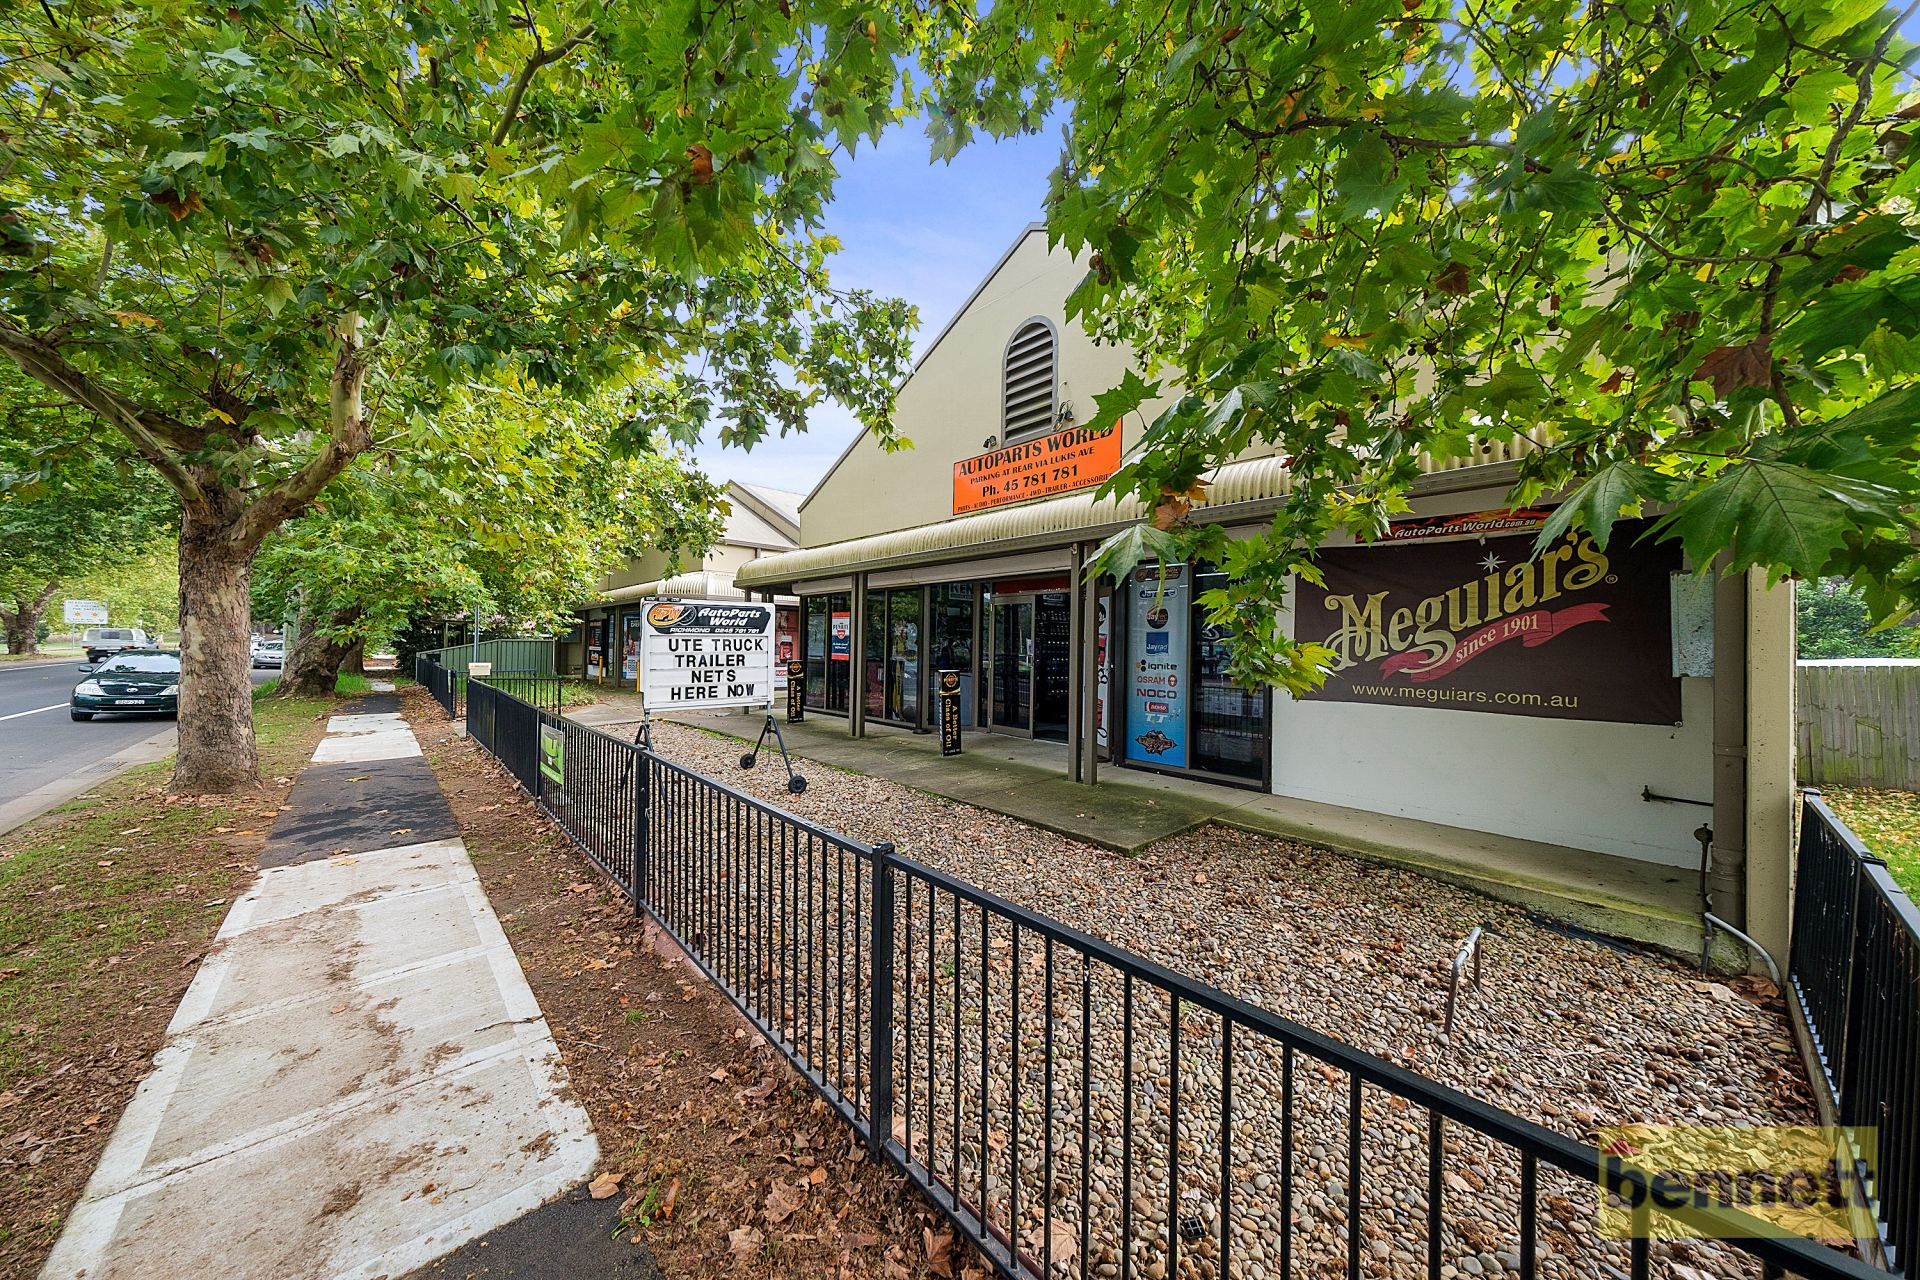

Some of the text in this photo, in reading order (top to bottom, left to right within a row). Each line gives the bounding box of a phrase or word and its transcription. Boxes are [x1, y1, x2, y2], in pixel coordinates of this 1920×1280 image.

[959, 428, 1114, 477] AUTOPARTS WORLD
[970, 446, 1095, 485] PARKING AT REAR VIA LUKIS AVE
[982, 464, 1078, 497] Ph. 45 781 781
[957, 504, 971, 512] PARTS
[990, 492, 1026, 505] PERFORMANCE
[1030, 489, 1042, 498] 4WD
[1045, 482, 1068, 494] TRAILER
[1323, 531, 1609, 674] Meguiar's
[698, 607, 762, 619] AutoParts
[710, 617, 748, 626] World
[668, 638, 763, 652] UTE TRUCK
[1456, 613, 1539, 663] since 1901
[1146, 643, 1169, 653] Jayrad
[675, 654, 746, 668] TRAILER
[691, 669, 736, 684] NETS
[1136, 675, 1166, 685] OSRAM
[670, 683, 755, 700] HERE NOW
[1136, 688, 1178, 700] NOCO
[1352, 684, 1578, 709] www.meguiars.com.au
[952, 705, 958, 713] A
[945, 723, 952, 732] of
